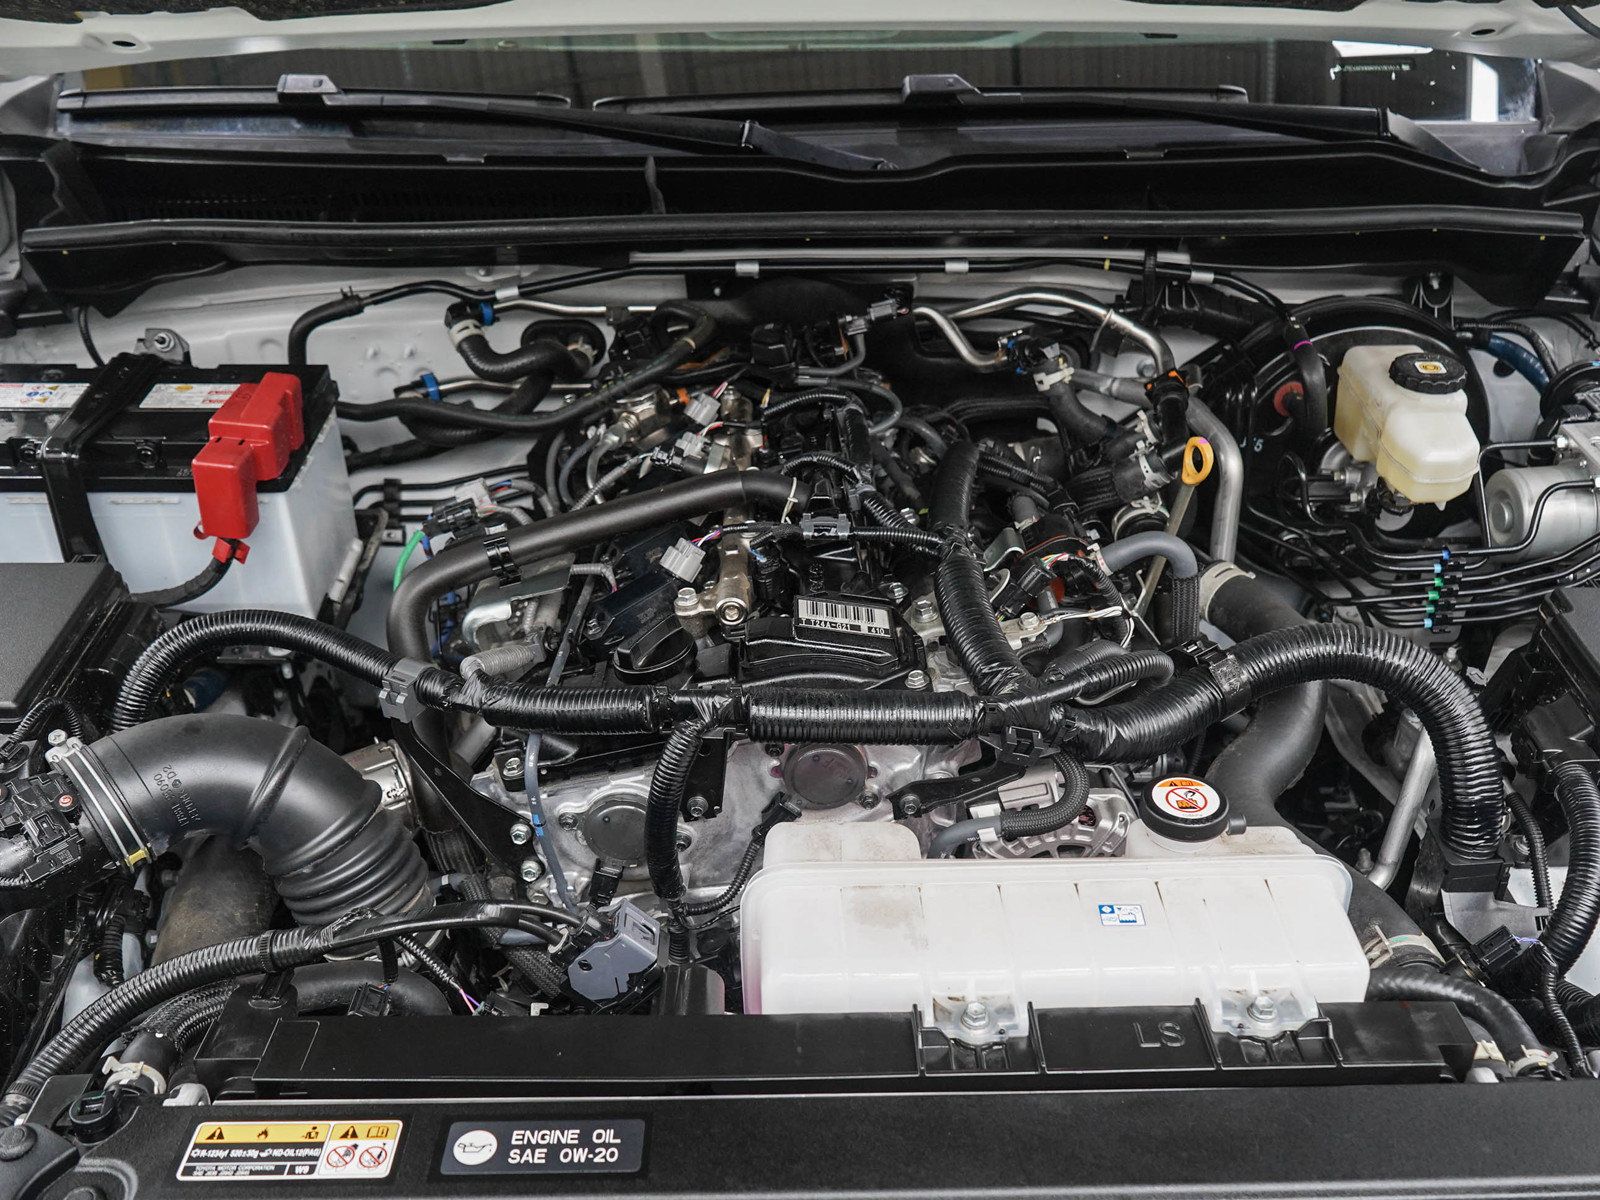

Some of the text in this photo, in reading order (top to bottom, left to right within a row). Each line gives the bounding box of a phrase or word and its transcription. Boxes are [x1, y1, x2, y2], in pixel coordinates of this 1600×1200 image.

[810, 619, 851, 631] T24A-G21
[870, 627, 885, 635] 410
[1132, 1021, 1186, 1048] LS
[511, 1129, 621, 1145] ENGINE OIL
[507, 1148, 619, 1164] SAE 0W-20
